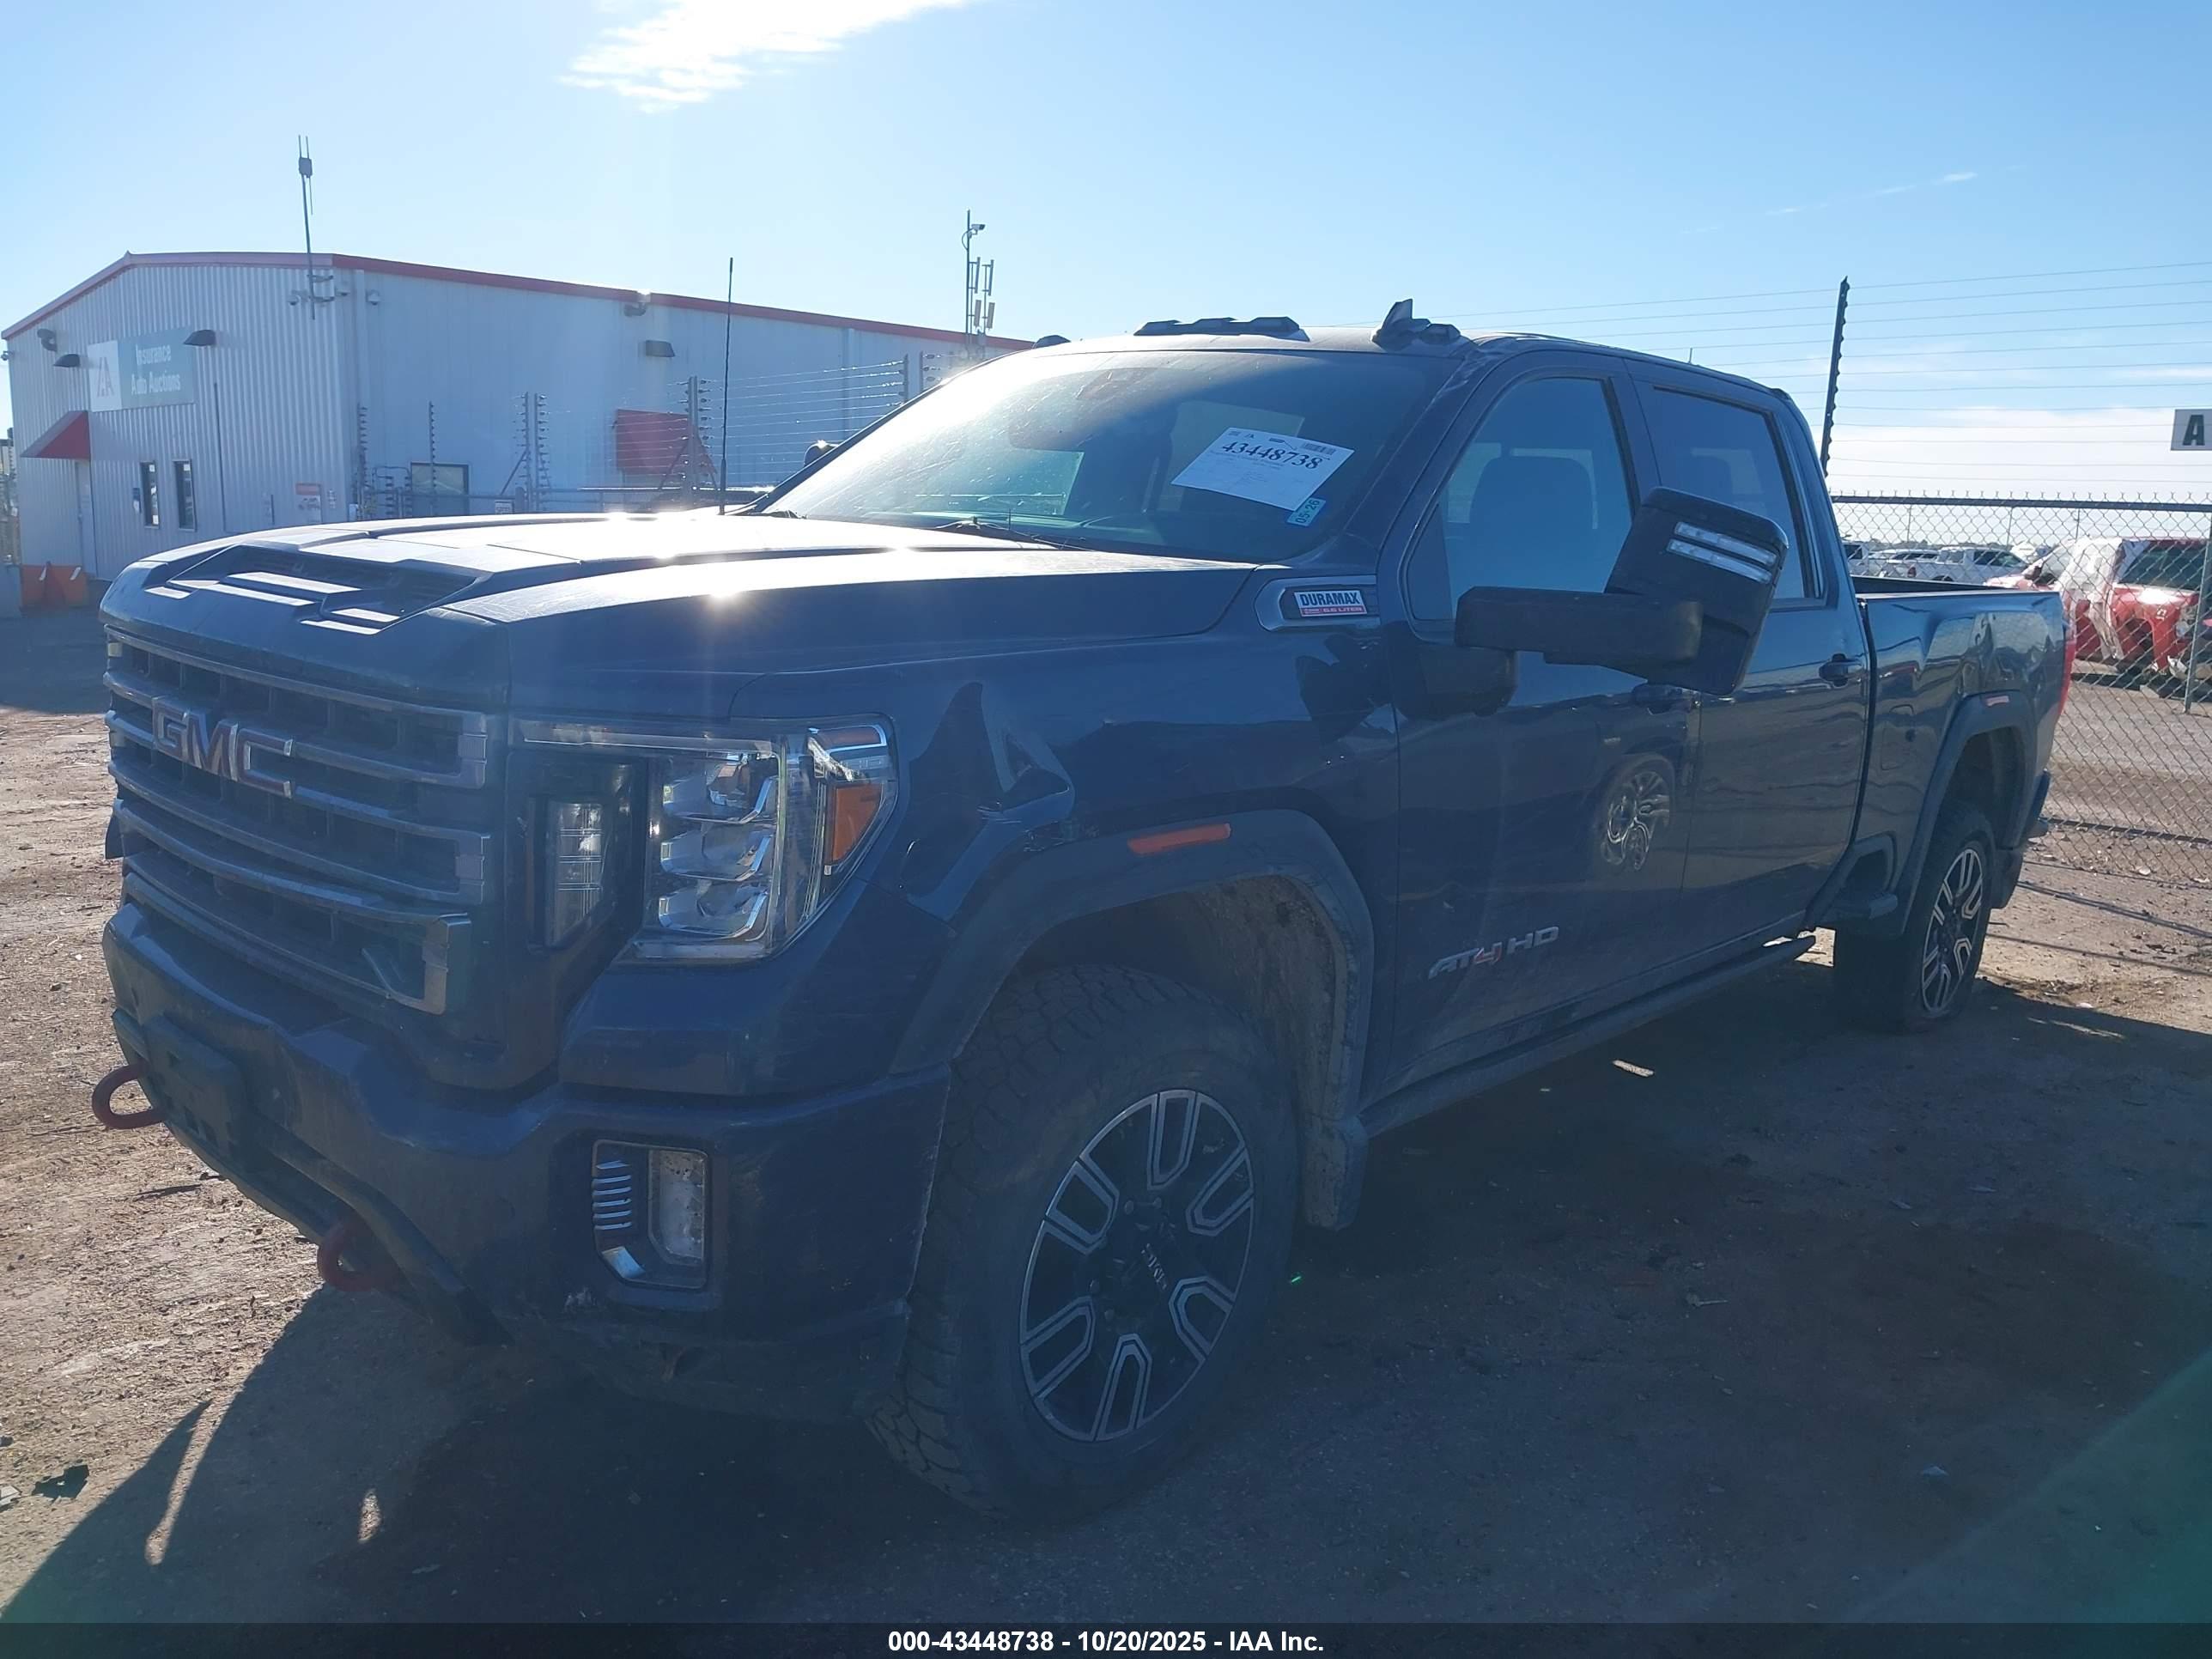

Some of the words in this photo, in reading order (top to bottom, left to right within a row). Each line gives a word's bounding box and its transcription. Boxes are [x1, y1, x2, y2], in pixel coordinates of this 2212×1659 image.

[135, 344, 172, 366] Insurance
[149, 369, 181, 394] Auctions
[2182, 414, 2206, 446] A
[1222, 441, 1323, 470] 43448738
[1299, 592, 1361, 606] DURAMAX
[151, 696, 294, 799] GMC
[1506, 926, 1559, 955] HD
